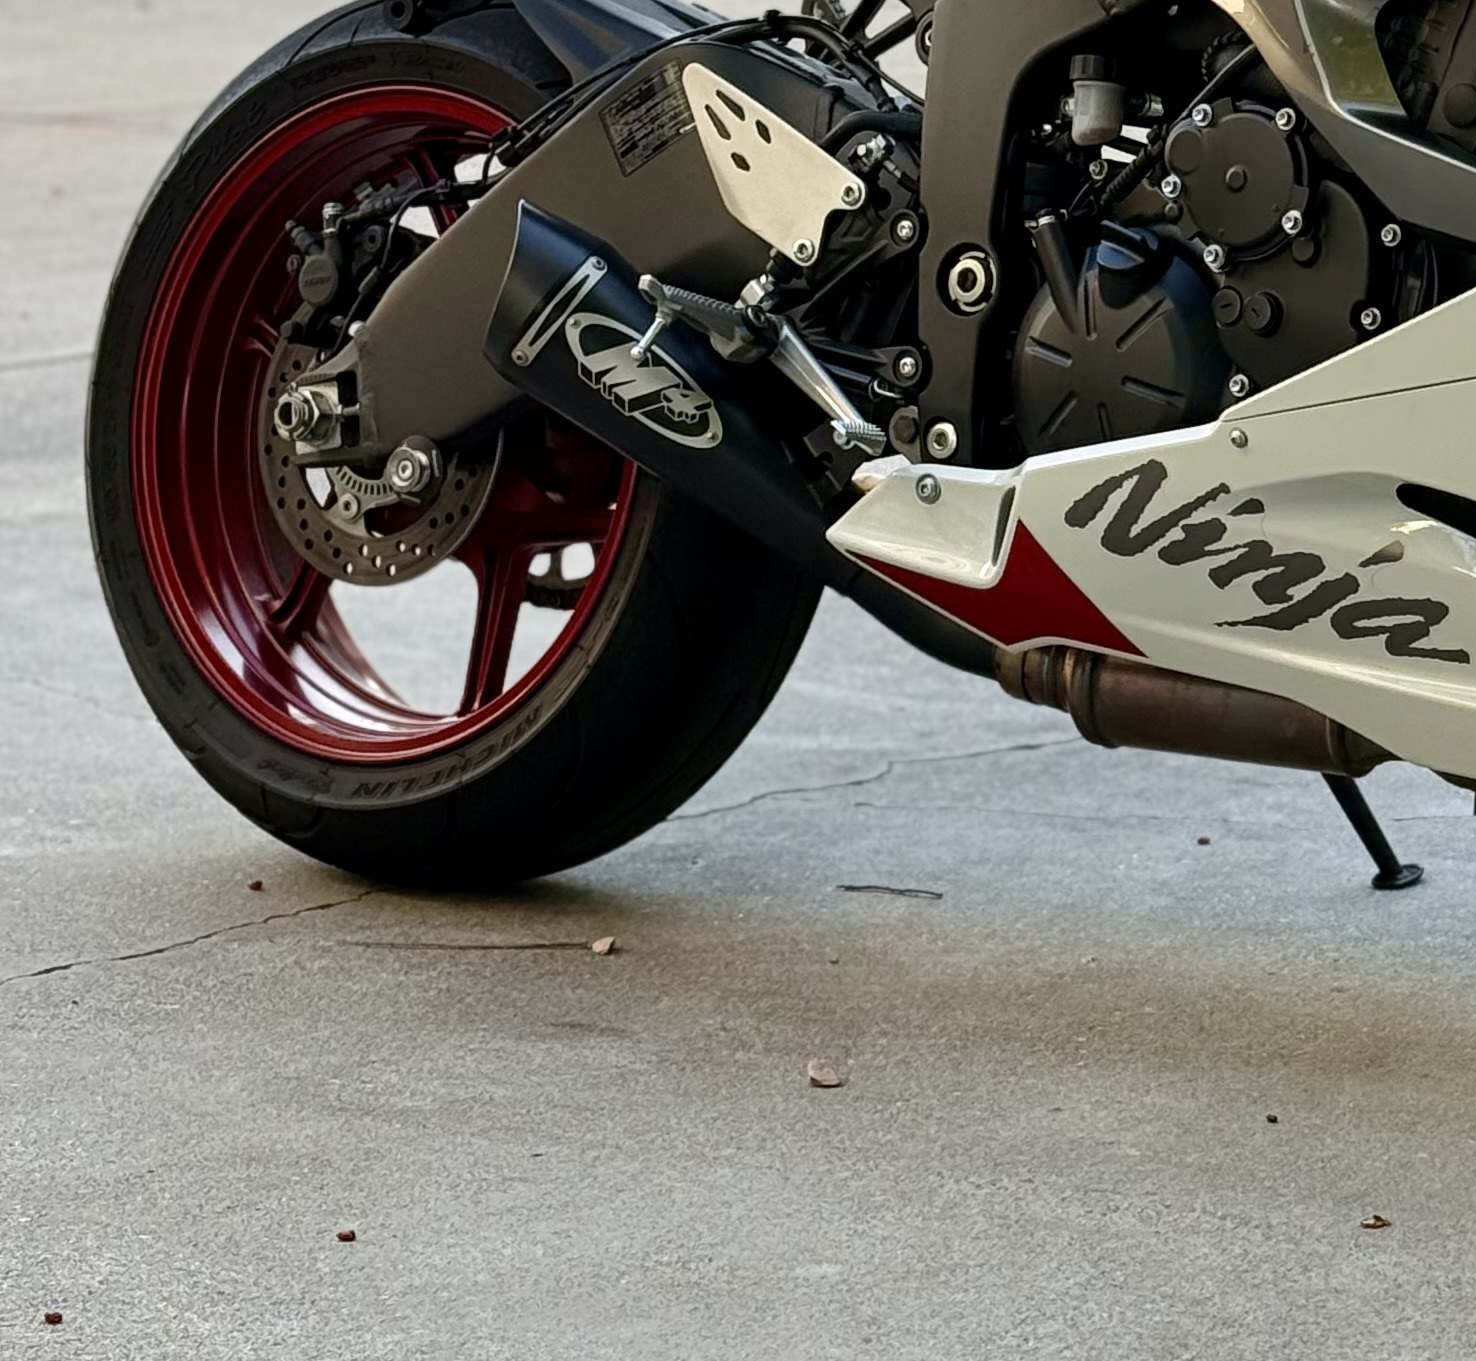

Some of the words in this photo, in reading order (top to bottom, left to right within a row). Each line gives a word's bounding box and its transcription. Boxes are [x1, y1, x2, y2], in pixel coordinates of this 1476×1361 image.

[577, 341, 714, 424] M4
[1064, 458, 1471, 664] Ninja
[351, 707, 544, 798] MICHELIN
